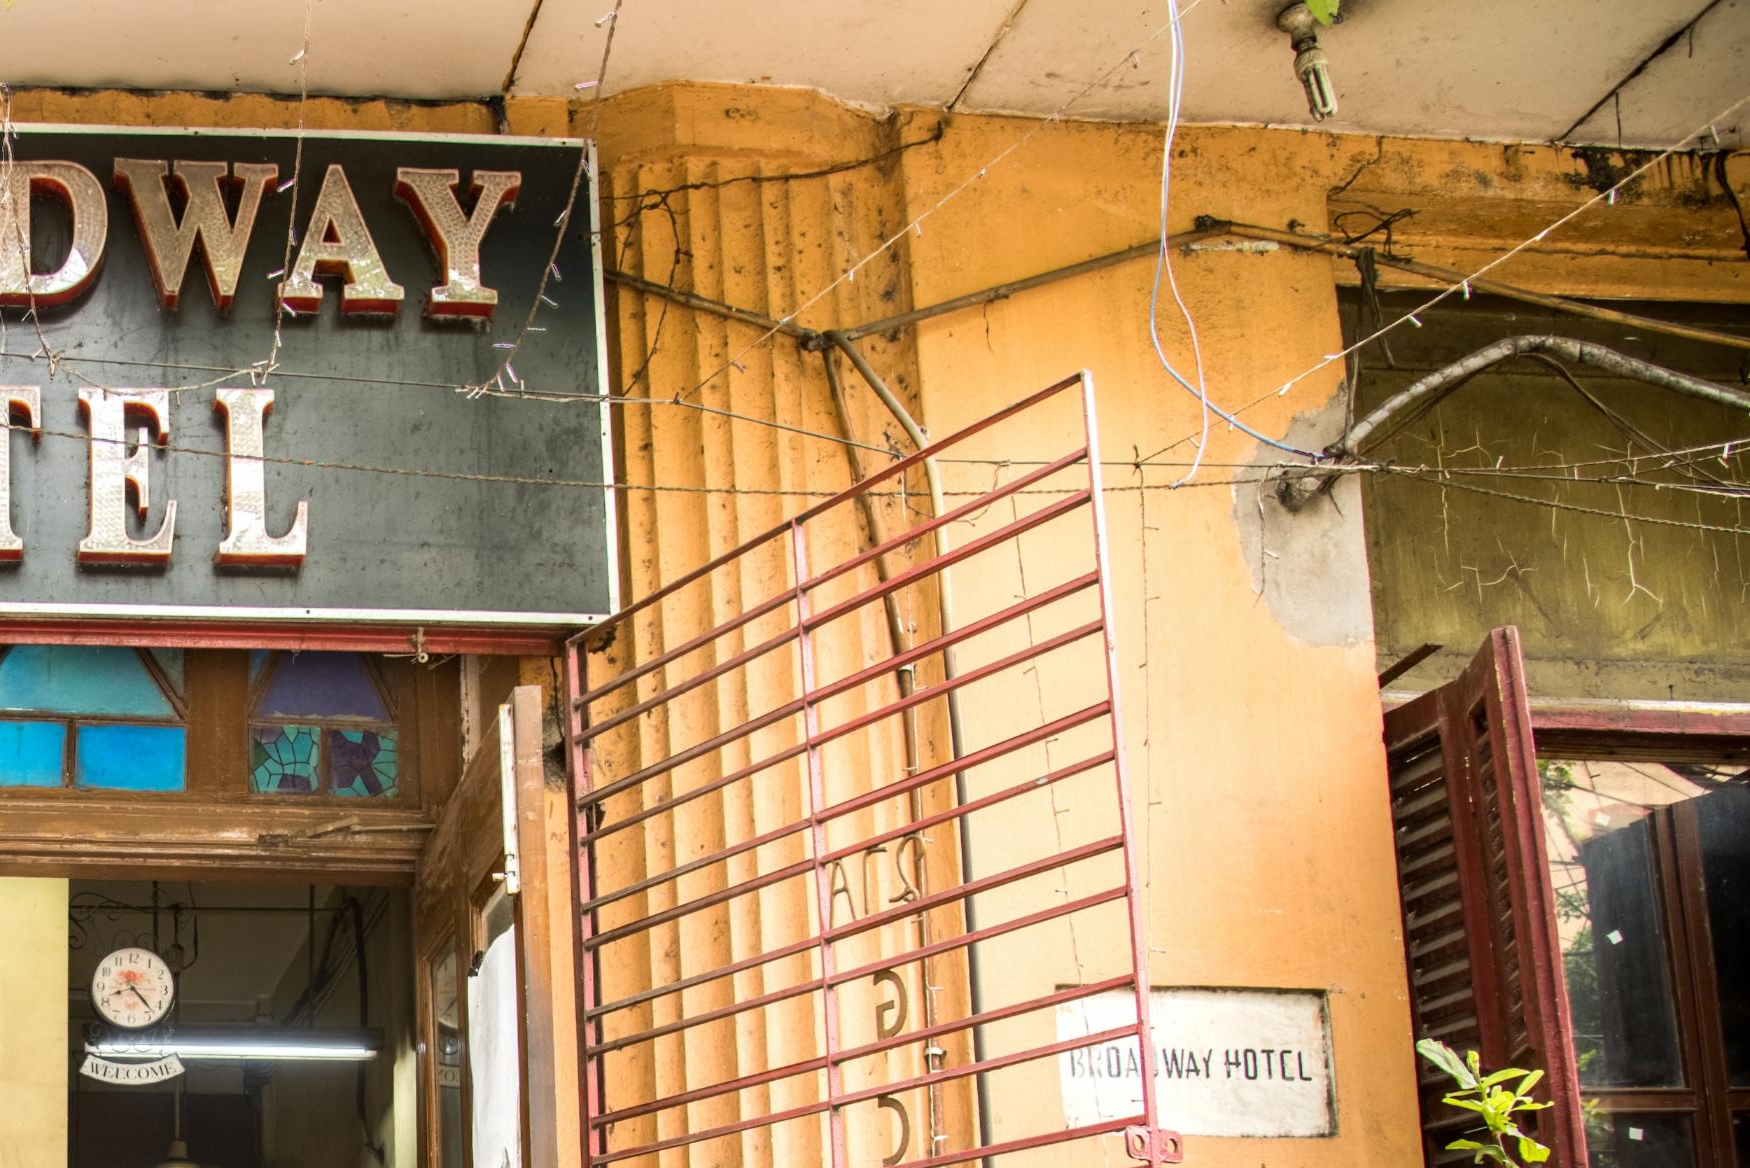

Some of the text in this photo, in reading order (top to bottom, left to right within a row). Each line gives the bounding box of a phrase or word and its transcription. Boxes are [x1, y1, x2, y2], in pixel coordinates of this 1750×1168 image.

[115, 956, 123, 967] 11
[129, 952, 140, 964] 12
[102, 966, 111, 977] 10
[157, 968, 164, 980] 2
[96, 981, 105, 992] 9
[159, 984, 168, 996] 3
[127, 1013, 136, 1024] 6
[1070, 1046, 1213, 1080] BROAWAY
[90, 1062, 177, 1080] WELCOME
